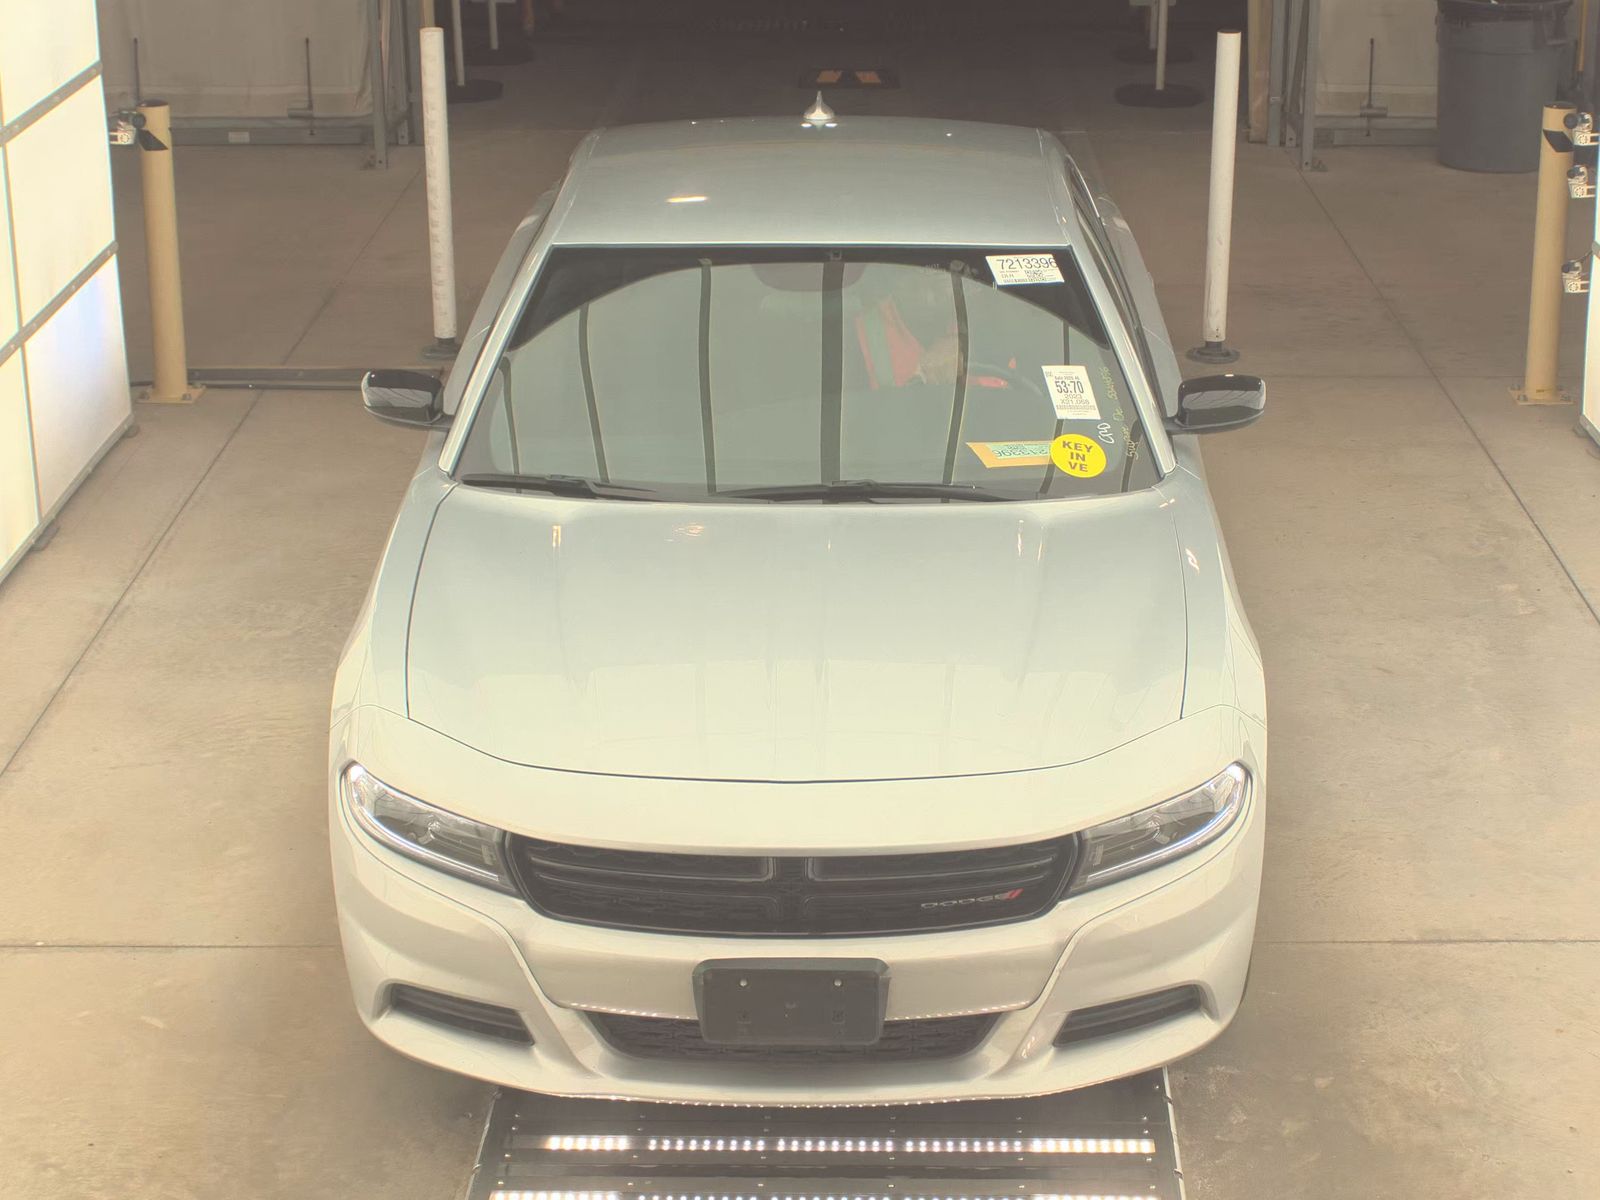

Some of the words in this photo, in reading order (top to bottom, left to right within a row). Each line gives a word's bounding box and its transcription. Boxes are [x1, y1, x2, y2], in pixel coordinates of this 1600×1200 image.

[996, 257, 1058, 269] 7213396
[1055, 381, 1084, 393] 53:70
[1062, 440, 1093, 453] KEY
[992, 448, 1048, 458] 213396
[1070, 452, 1086, 462] IN
[1068, 463, 1088, 473] VE
[920, 893, 1007, 909] DODGE
